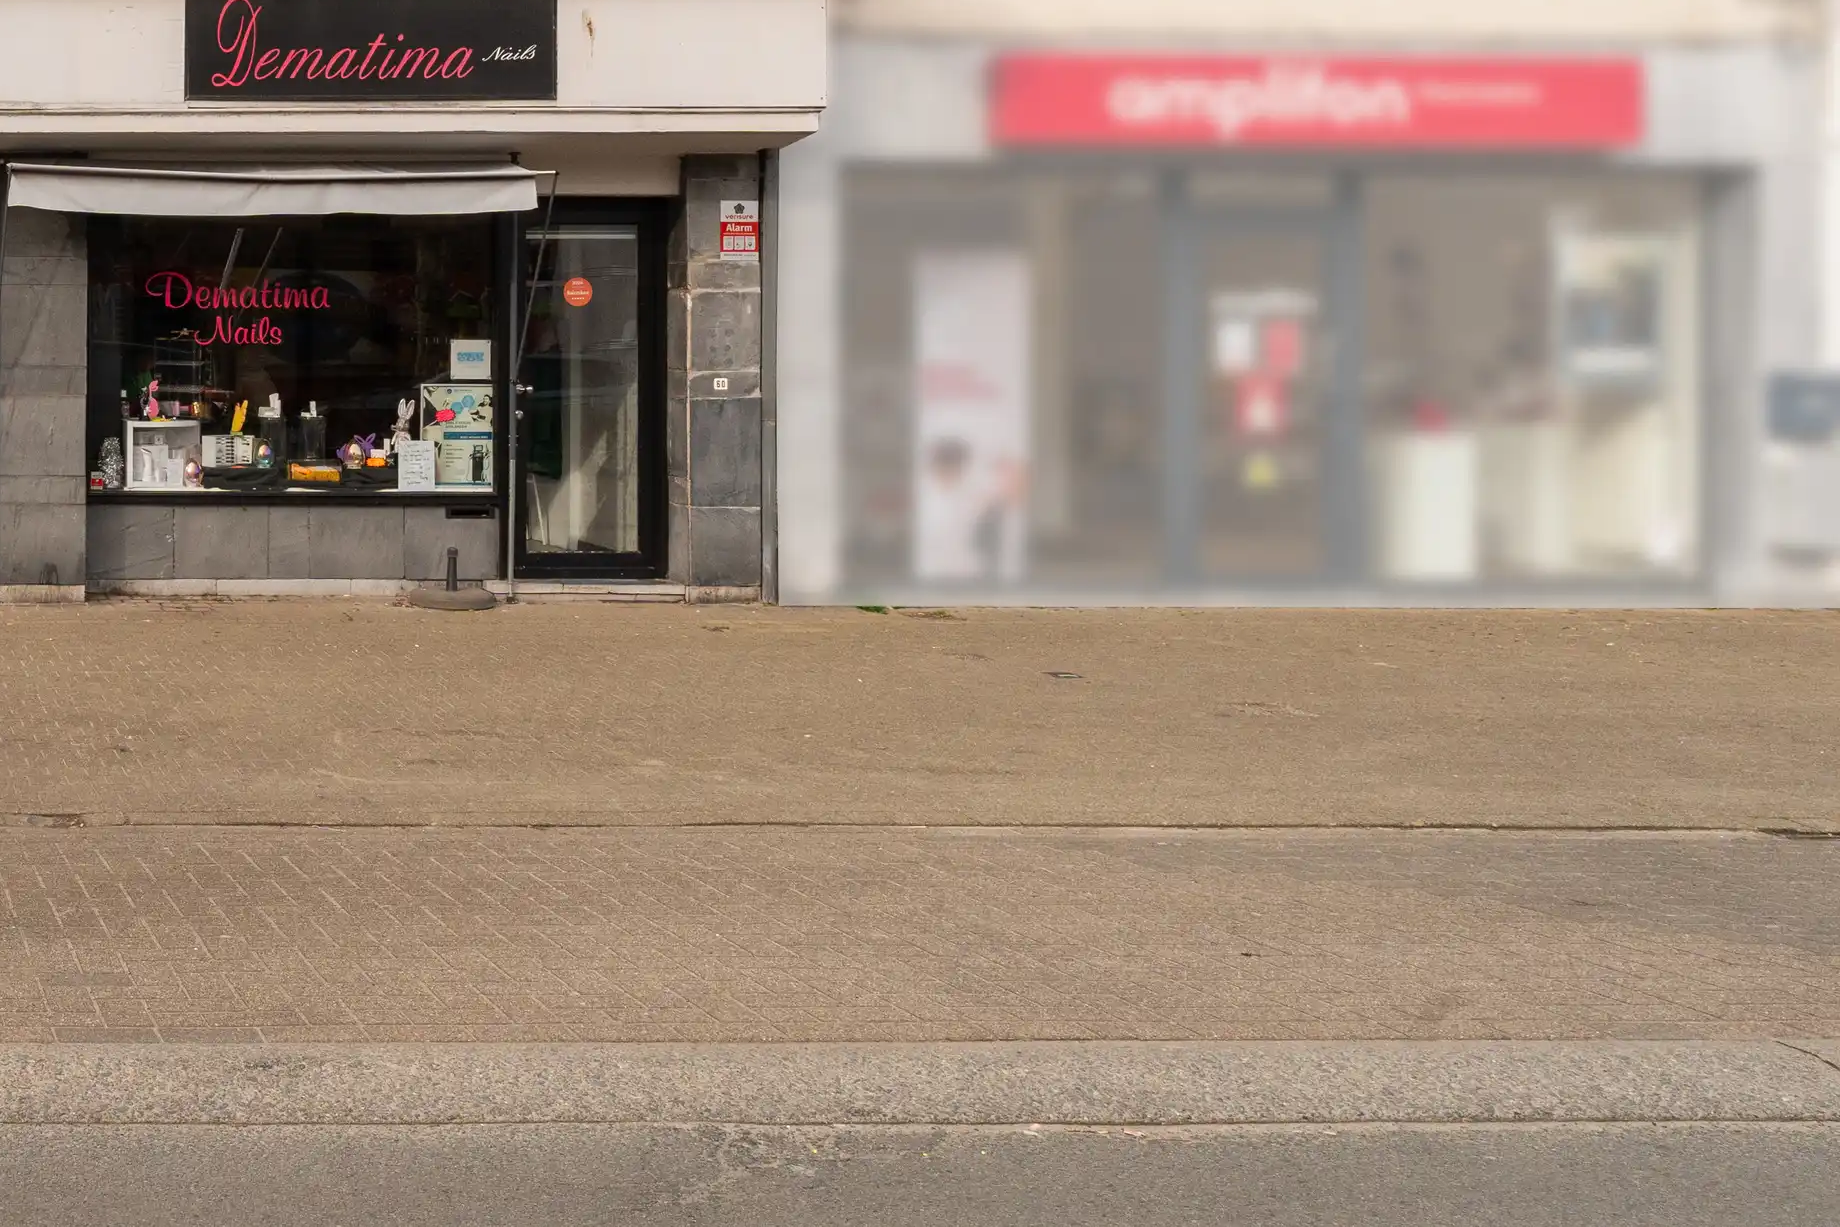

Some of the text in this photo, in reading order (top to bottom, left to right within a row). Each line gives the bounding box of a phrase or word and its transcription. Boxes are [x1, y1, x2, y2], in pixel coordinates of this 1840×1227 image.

[481, 44, 538, 62] Nails
[726, 223, 753, 232] Alarm
[145, 271, 331, 309] Dematima
[194, 315, 283, 346] Nails
[716, 380, 726, 388] 60
